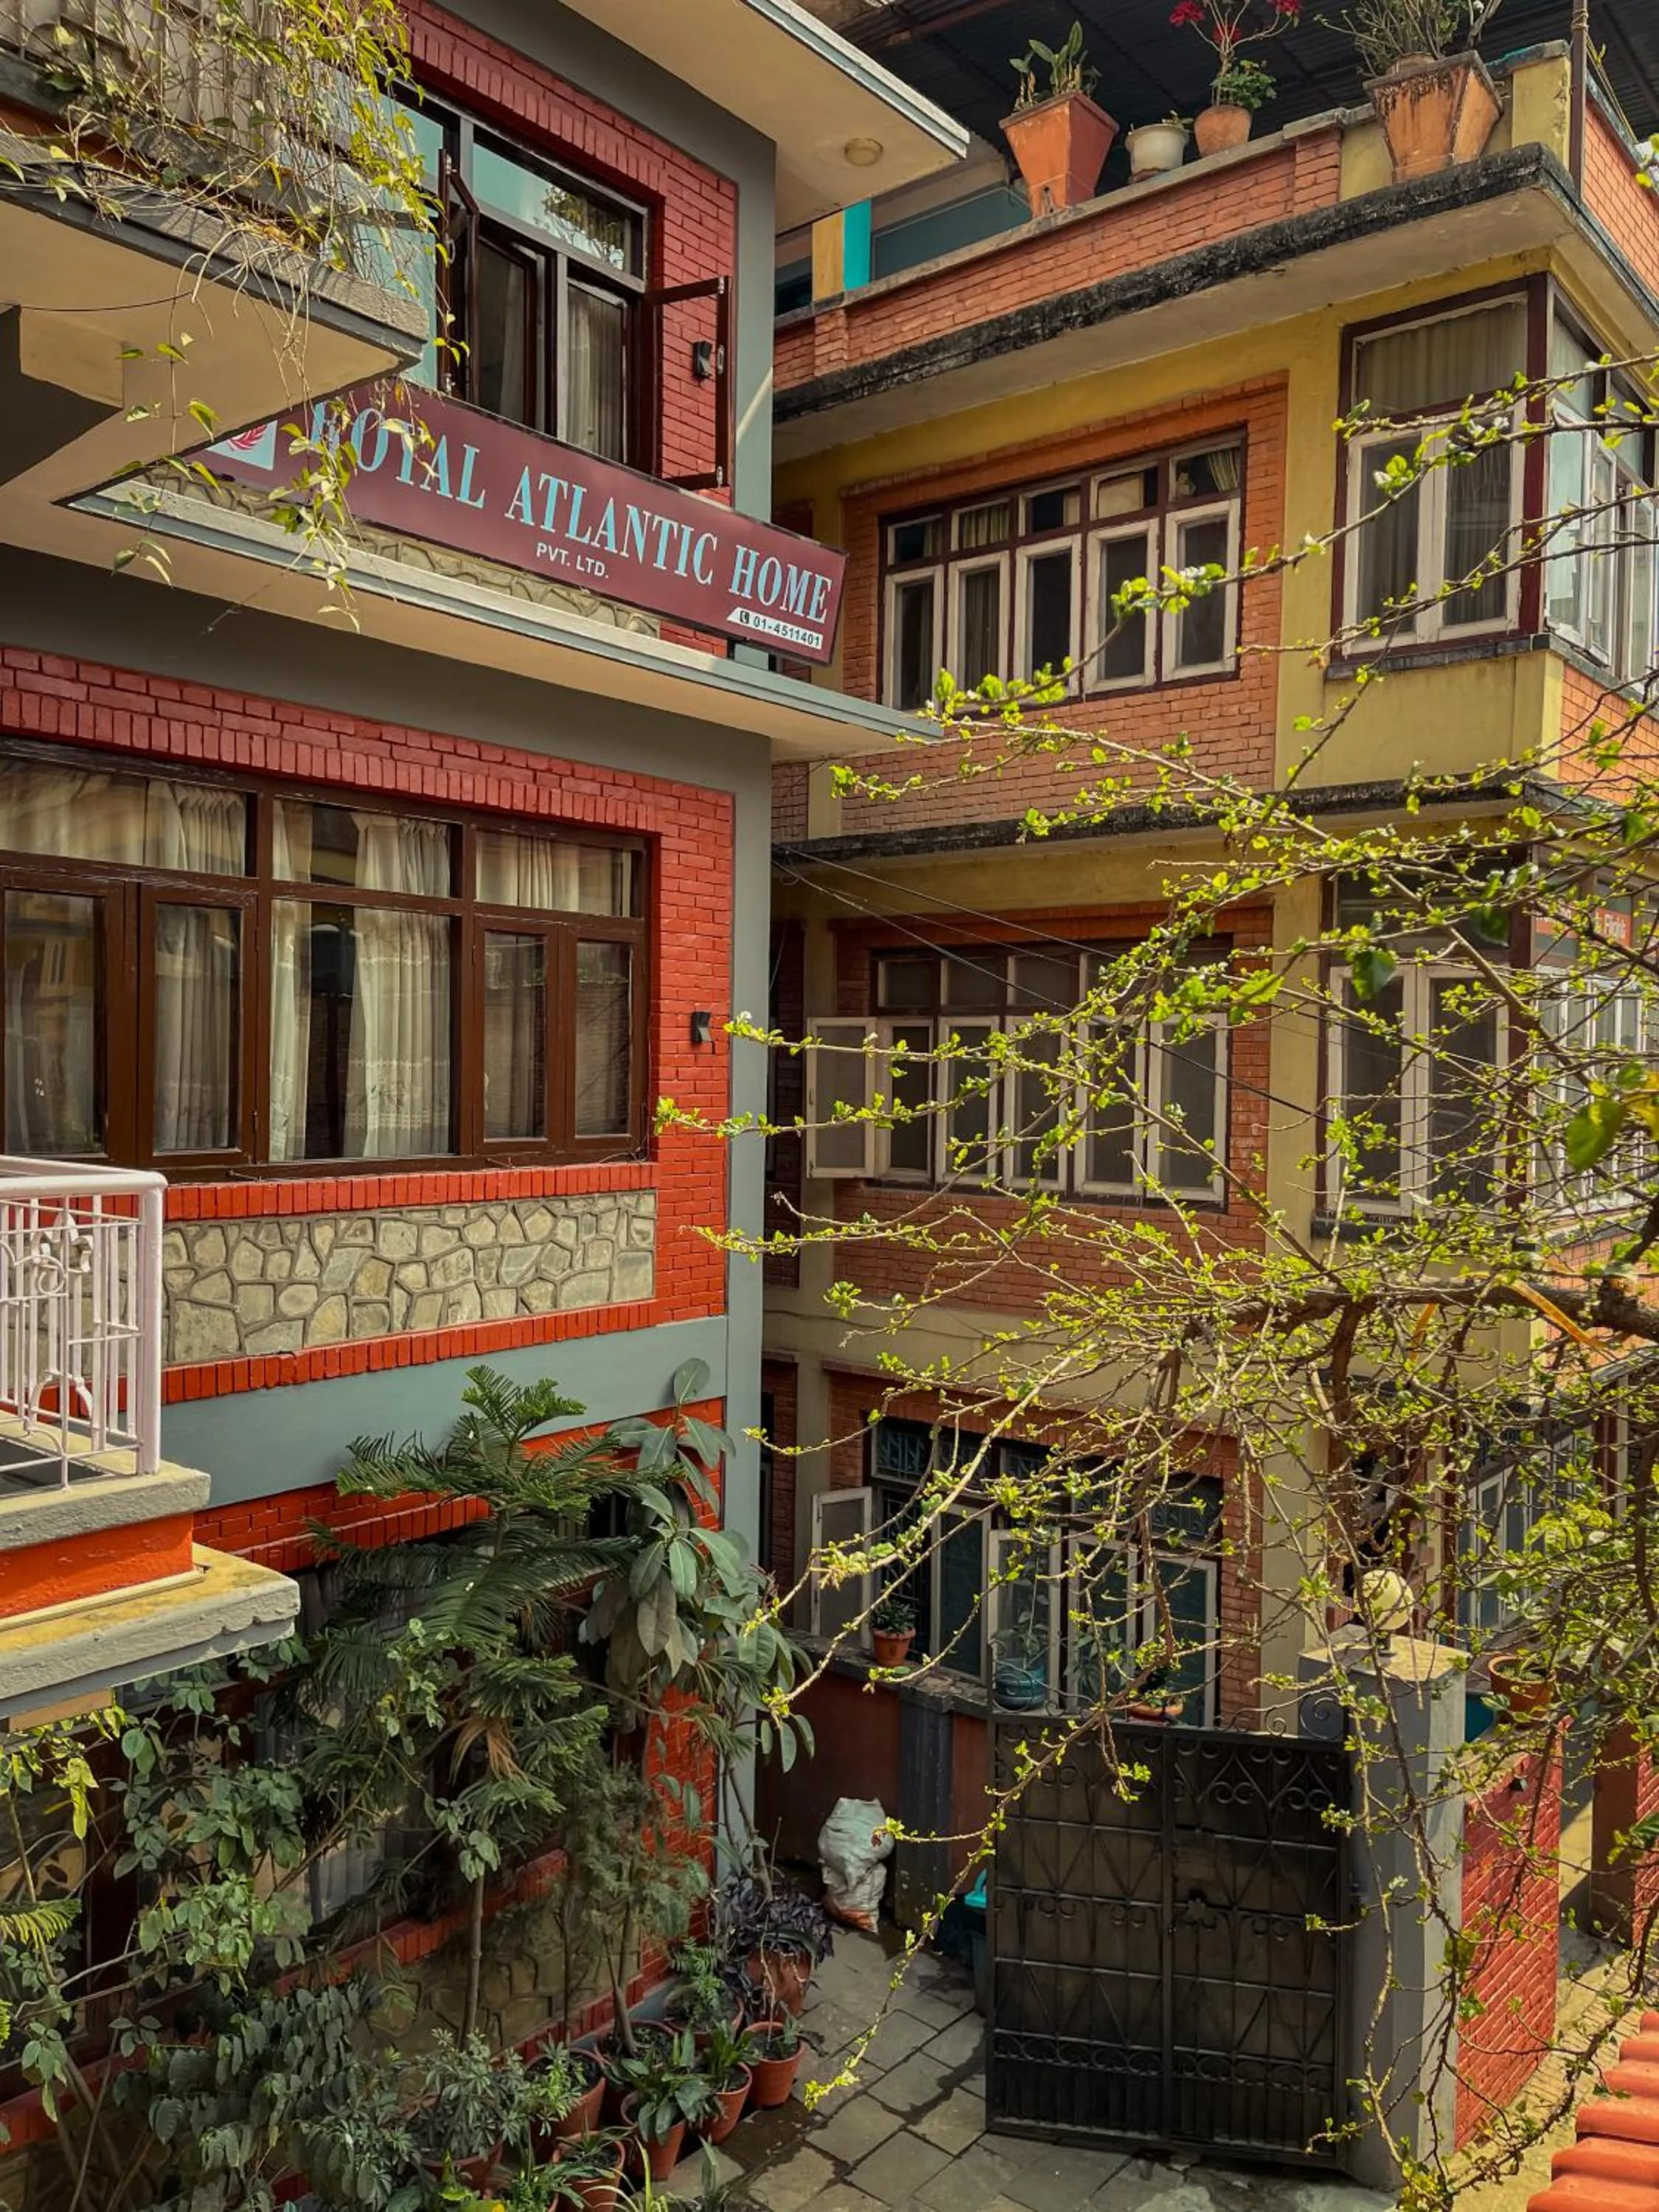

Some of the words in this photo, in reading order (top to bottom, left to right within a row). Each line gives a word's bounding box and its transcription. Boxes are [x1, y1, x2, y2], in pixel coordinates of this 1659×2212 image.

[504, 465, 718, 585] ATLANTIC
[728, 543, 833, 626] HOME
[536, 542, 571, 567] PVT.
[575, 555, 610, 580] LTD.
[753, 614, 821, 647] 01-4511401
